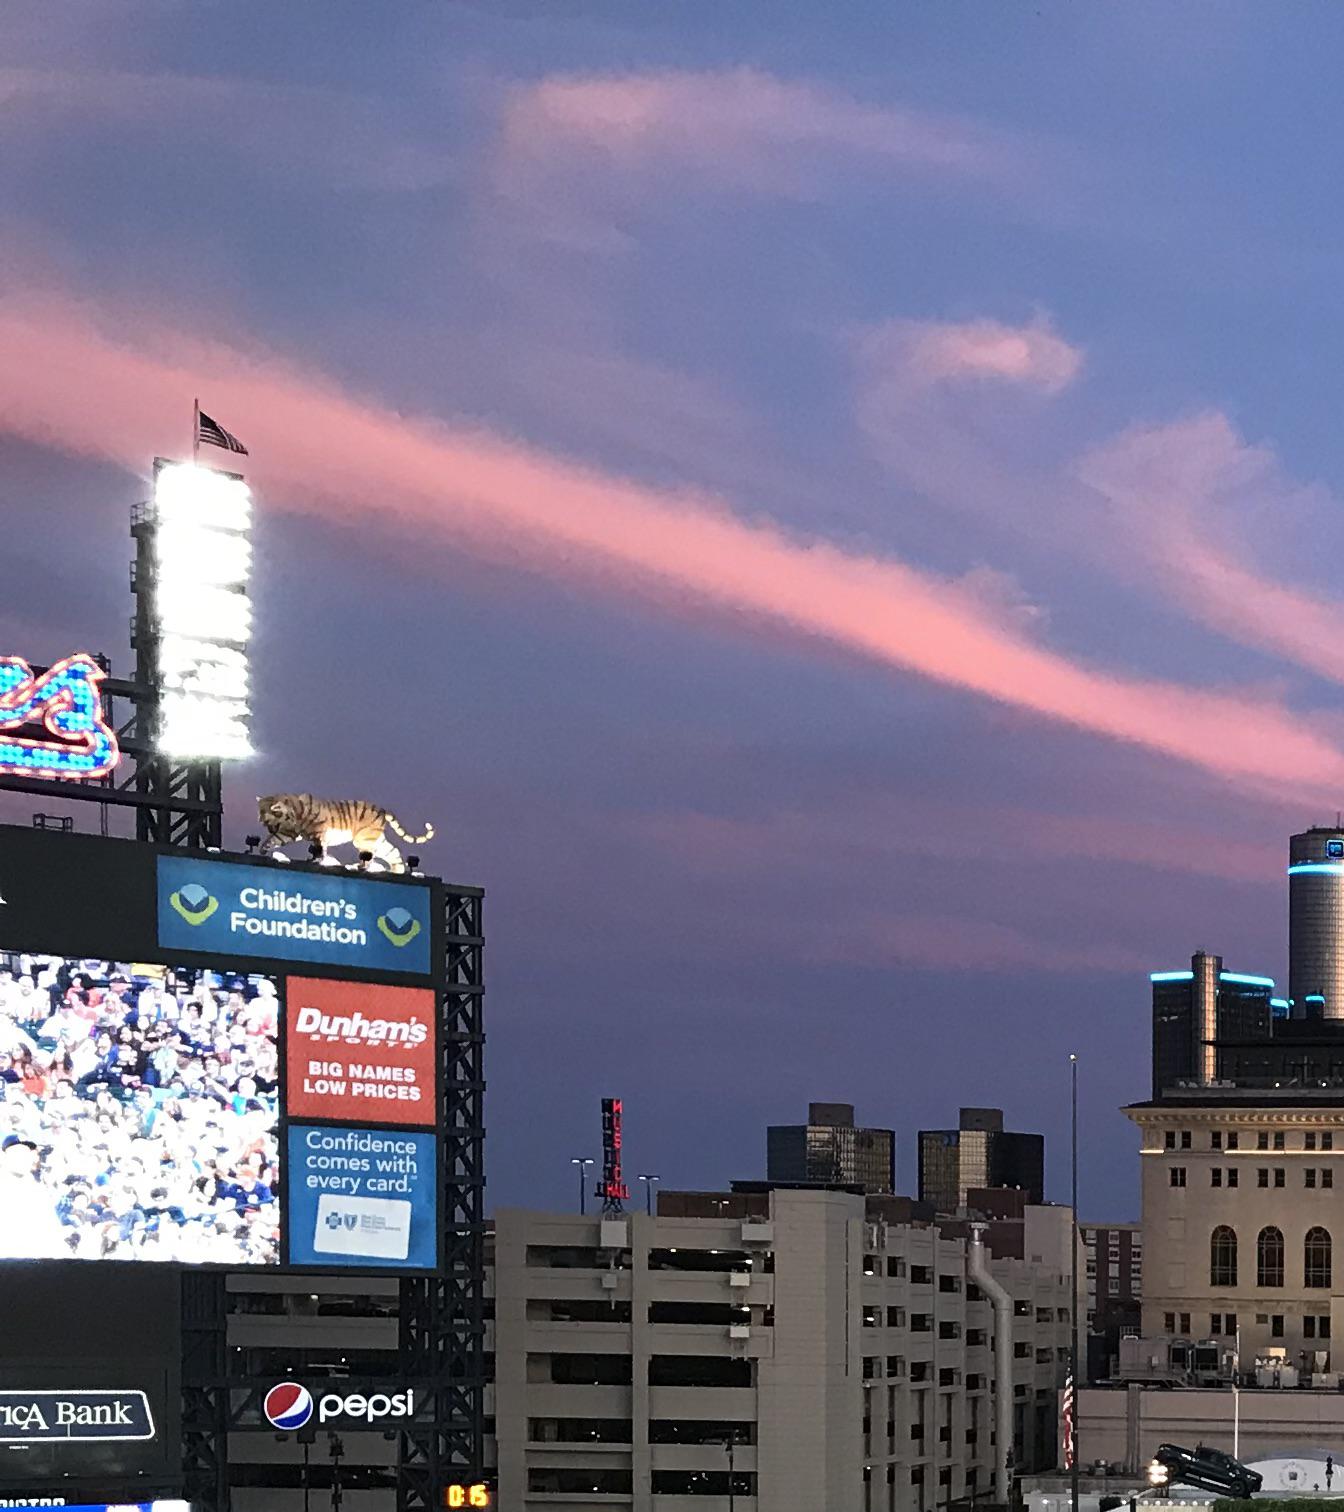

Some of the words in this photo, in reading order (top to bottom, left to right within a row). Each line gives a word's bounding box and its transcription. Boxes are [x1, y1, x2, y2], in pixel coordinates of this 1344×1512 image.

[240, 888, 357, 920] Children's
[230, 911, 367, 946] Foundation
[296, 1007, 428, 1043] Dunham's
[308, 1061, 343, 1077] BIG
[348, 1064, 416, 1083] NAMES
[304, 1079, 347, 1095] LOW
[352, 1081, 421, 1101] PRICES
[306, 1131, 417, 1154] Confidence
[306, 1156, 370, 1172] comes
[376, 1157, 417, 1174] with
[306, 1175, 361, 1194] every
[366, 1175, 413, 1193] card.
[55, 1401, 134, 1425] Bank
[318, 1388, 415, 1423] pepsi
